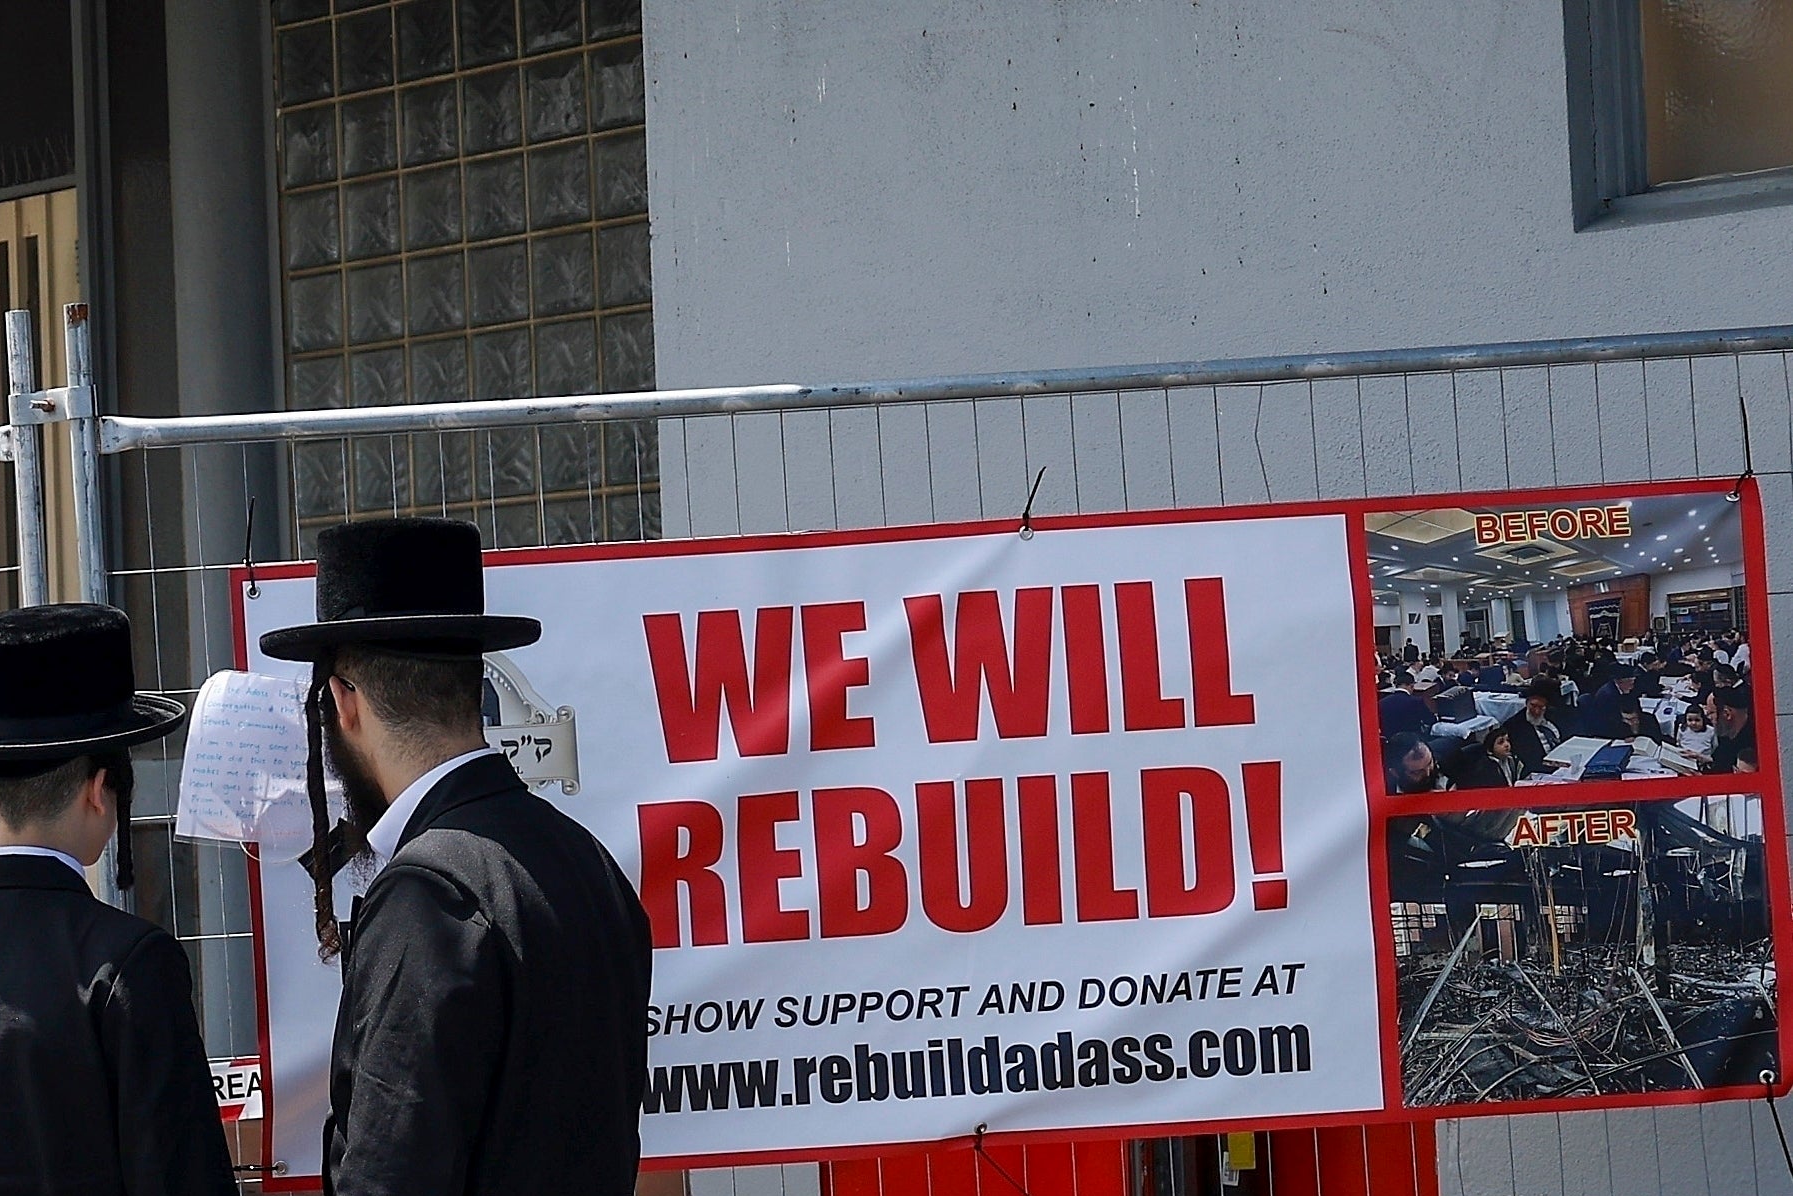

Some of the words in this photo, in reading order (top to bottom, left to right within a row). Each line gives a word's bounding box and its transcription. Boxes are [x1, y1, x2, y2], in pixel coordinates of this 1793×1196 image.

[1474, 505, 1632, 546] BEFORE
[642, 601, 876, 764] WE
[902, 576, 1256, 744] WILL
[638, 760, 1288, 950] REBUILD!
[1511, 809, 1637, 848] AFTER
[647, 998, 765, 1037] SHOW
[773, 986, 970, 1029] SUPPORT
[978, 980, 1066, 1016] AND
[1076, 968, 1242, 1011] DONATE
[1250, 964, 1305, 998] AT
[211, 1071, 263, 1101] REA
[643, 1022, 1311, 1114] www.rebuildadass.com
